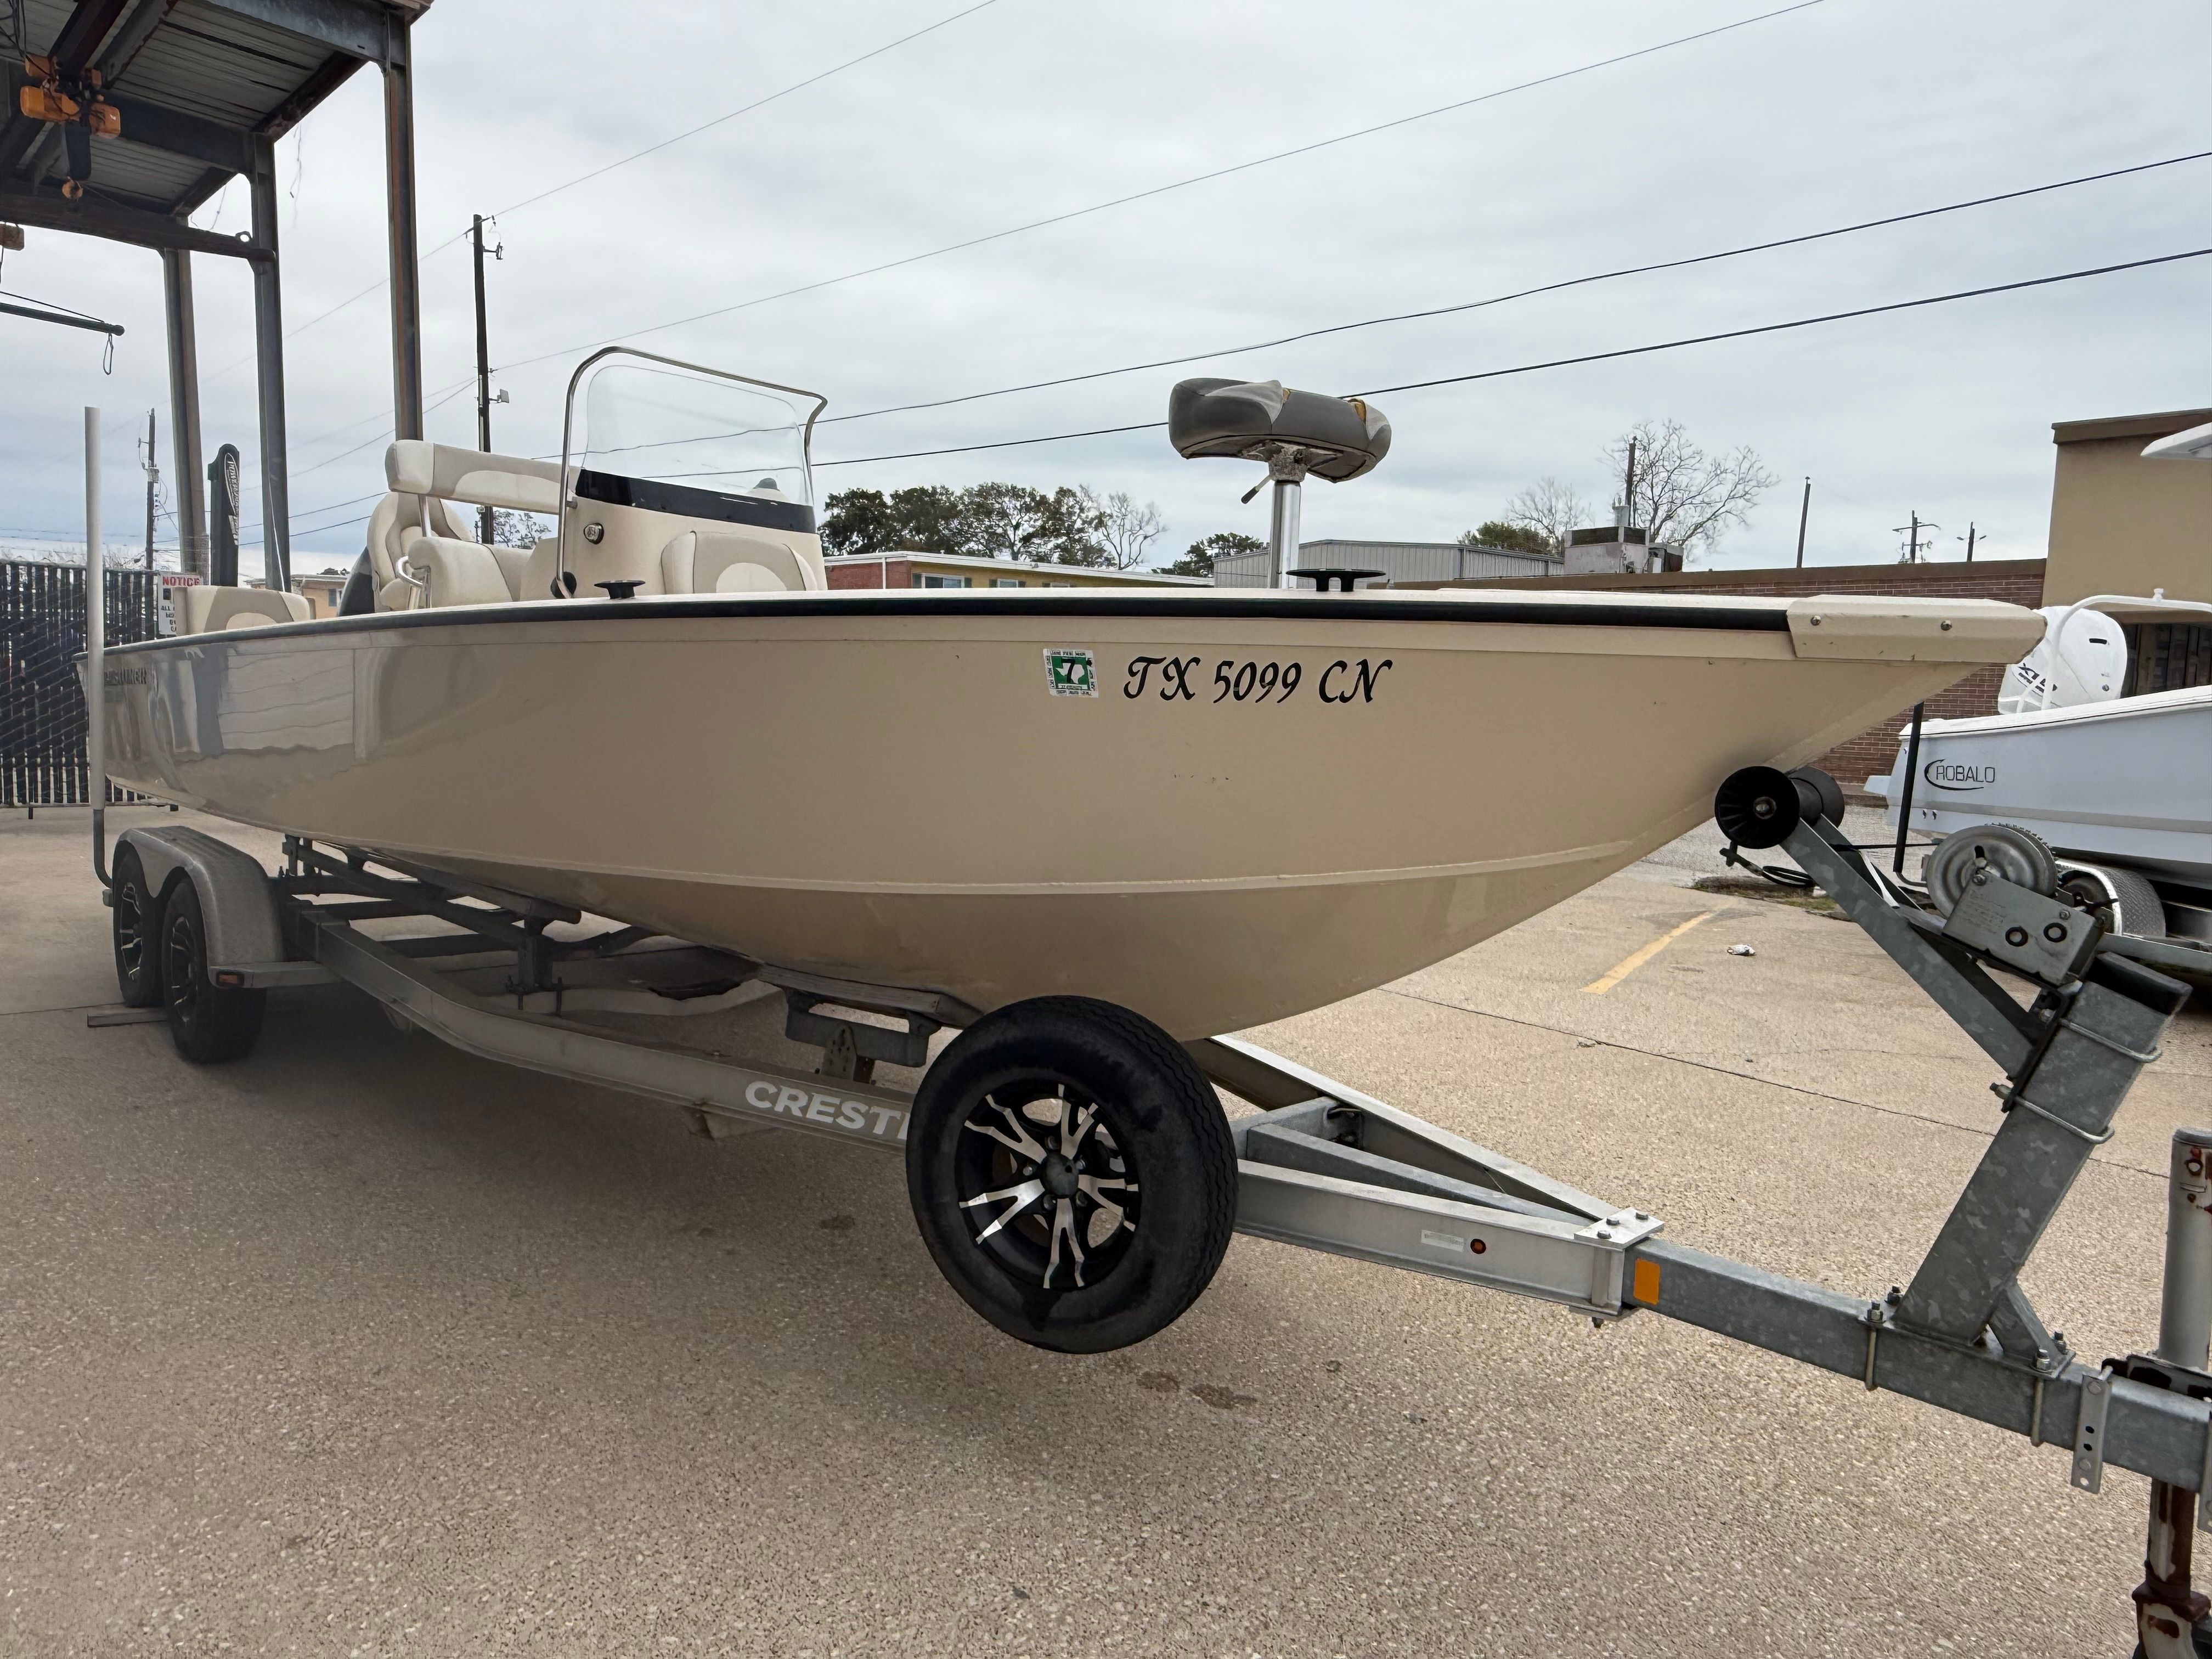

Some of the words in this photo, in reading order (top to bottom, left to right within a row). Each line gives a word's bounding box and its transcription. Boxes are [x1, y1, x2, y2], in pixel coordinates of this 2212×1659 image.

[162, 575, 200, 586] NOTICE
[1060, 658, 1076, 683] 7
[1123, 656, 1201, 701] TX
[1213, 660, 1302, 704] 5099
[1318, 658, 1393, 703] CN
[1936, 765, 1996, 783] ROBALO
